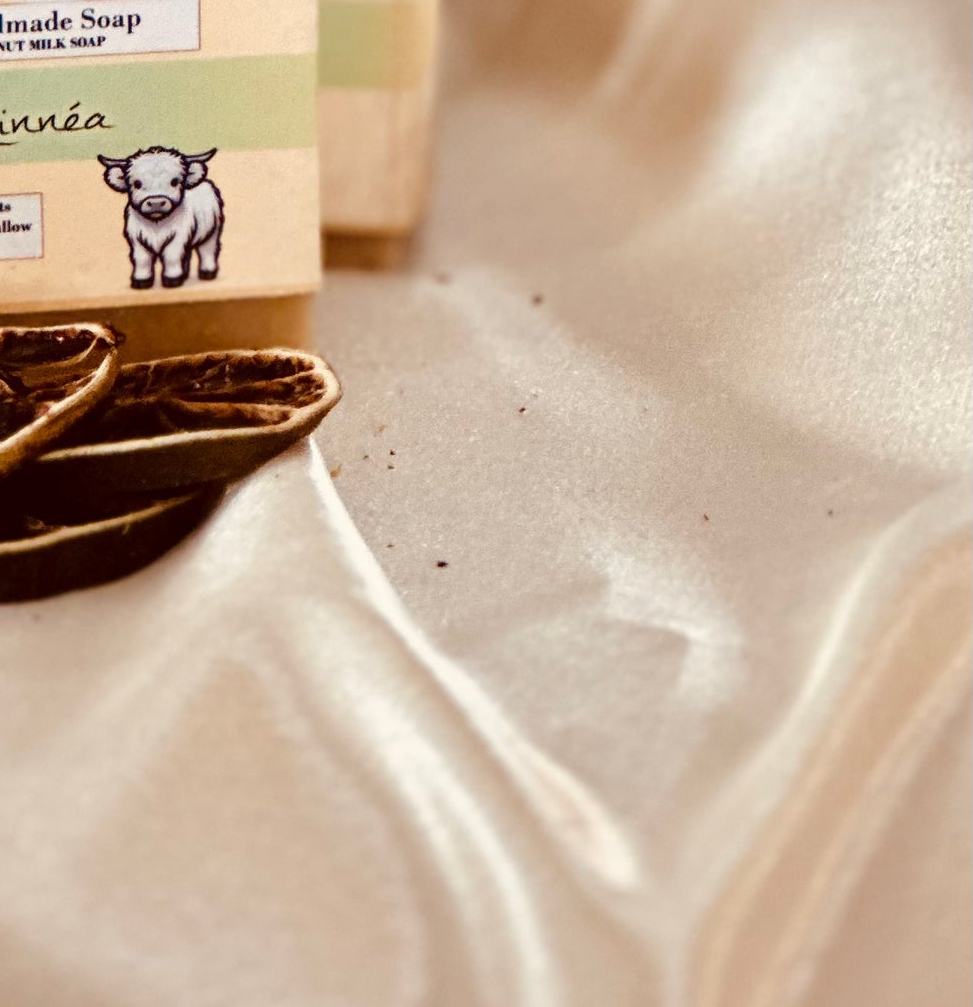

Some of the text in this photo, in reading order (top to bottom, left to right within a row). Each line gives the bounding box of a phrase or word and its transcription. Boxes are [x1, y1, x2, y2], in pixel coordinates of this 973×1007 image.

[80, 8, 141, 34] Soap
[29, 38, 66, 51] MILK
[69, 36, 107, 48] SOAP
